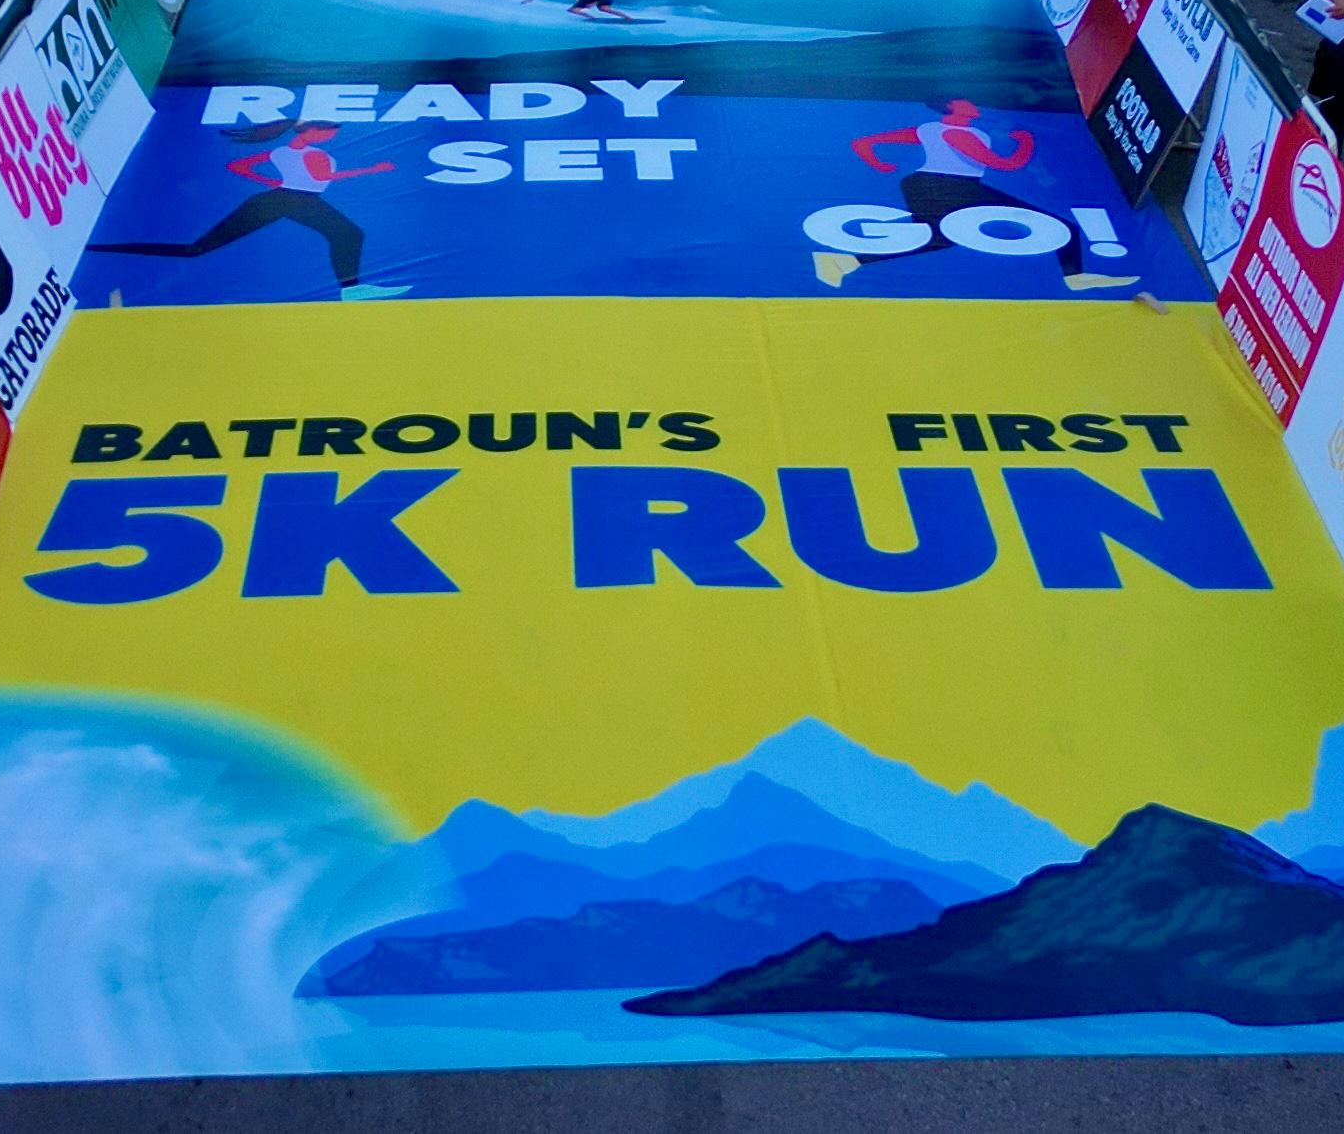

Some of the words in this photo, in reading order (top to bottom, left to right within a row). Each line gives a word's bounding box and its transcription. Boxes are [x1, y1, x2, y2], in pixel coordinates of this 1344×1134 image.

[202, 79, 685, 125] READY
[1115, 77, 1162, 155] FOOTLAB
[424, 137, 698, 184] SET
[802, 203, 1129, 258] GO!
[1258, 217, 1301, 294] OUTDOOR
[1292, 269, 1326, 334] MEDIA
[1244, 252, 1264, 291] ALL
[1256, 271, 1282, 318] OVER
[1273, 297, 1312, 369] LEBANON
[70, 410, 721, 463] BATROUN'S
[886, 413, 1190, 454] FIRST
[23, 468, 461, 604] 5K
[570, 467, 1274, 592] RUN
